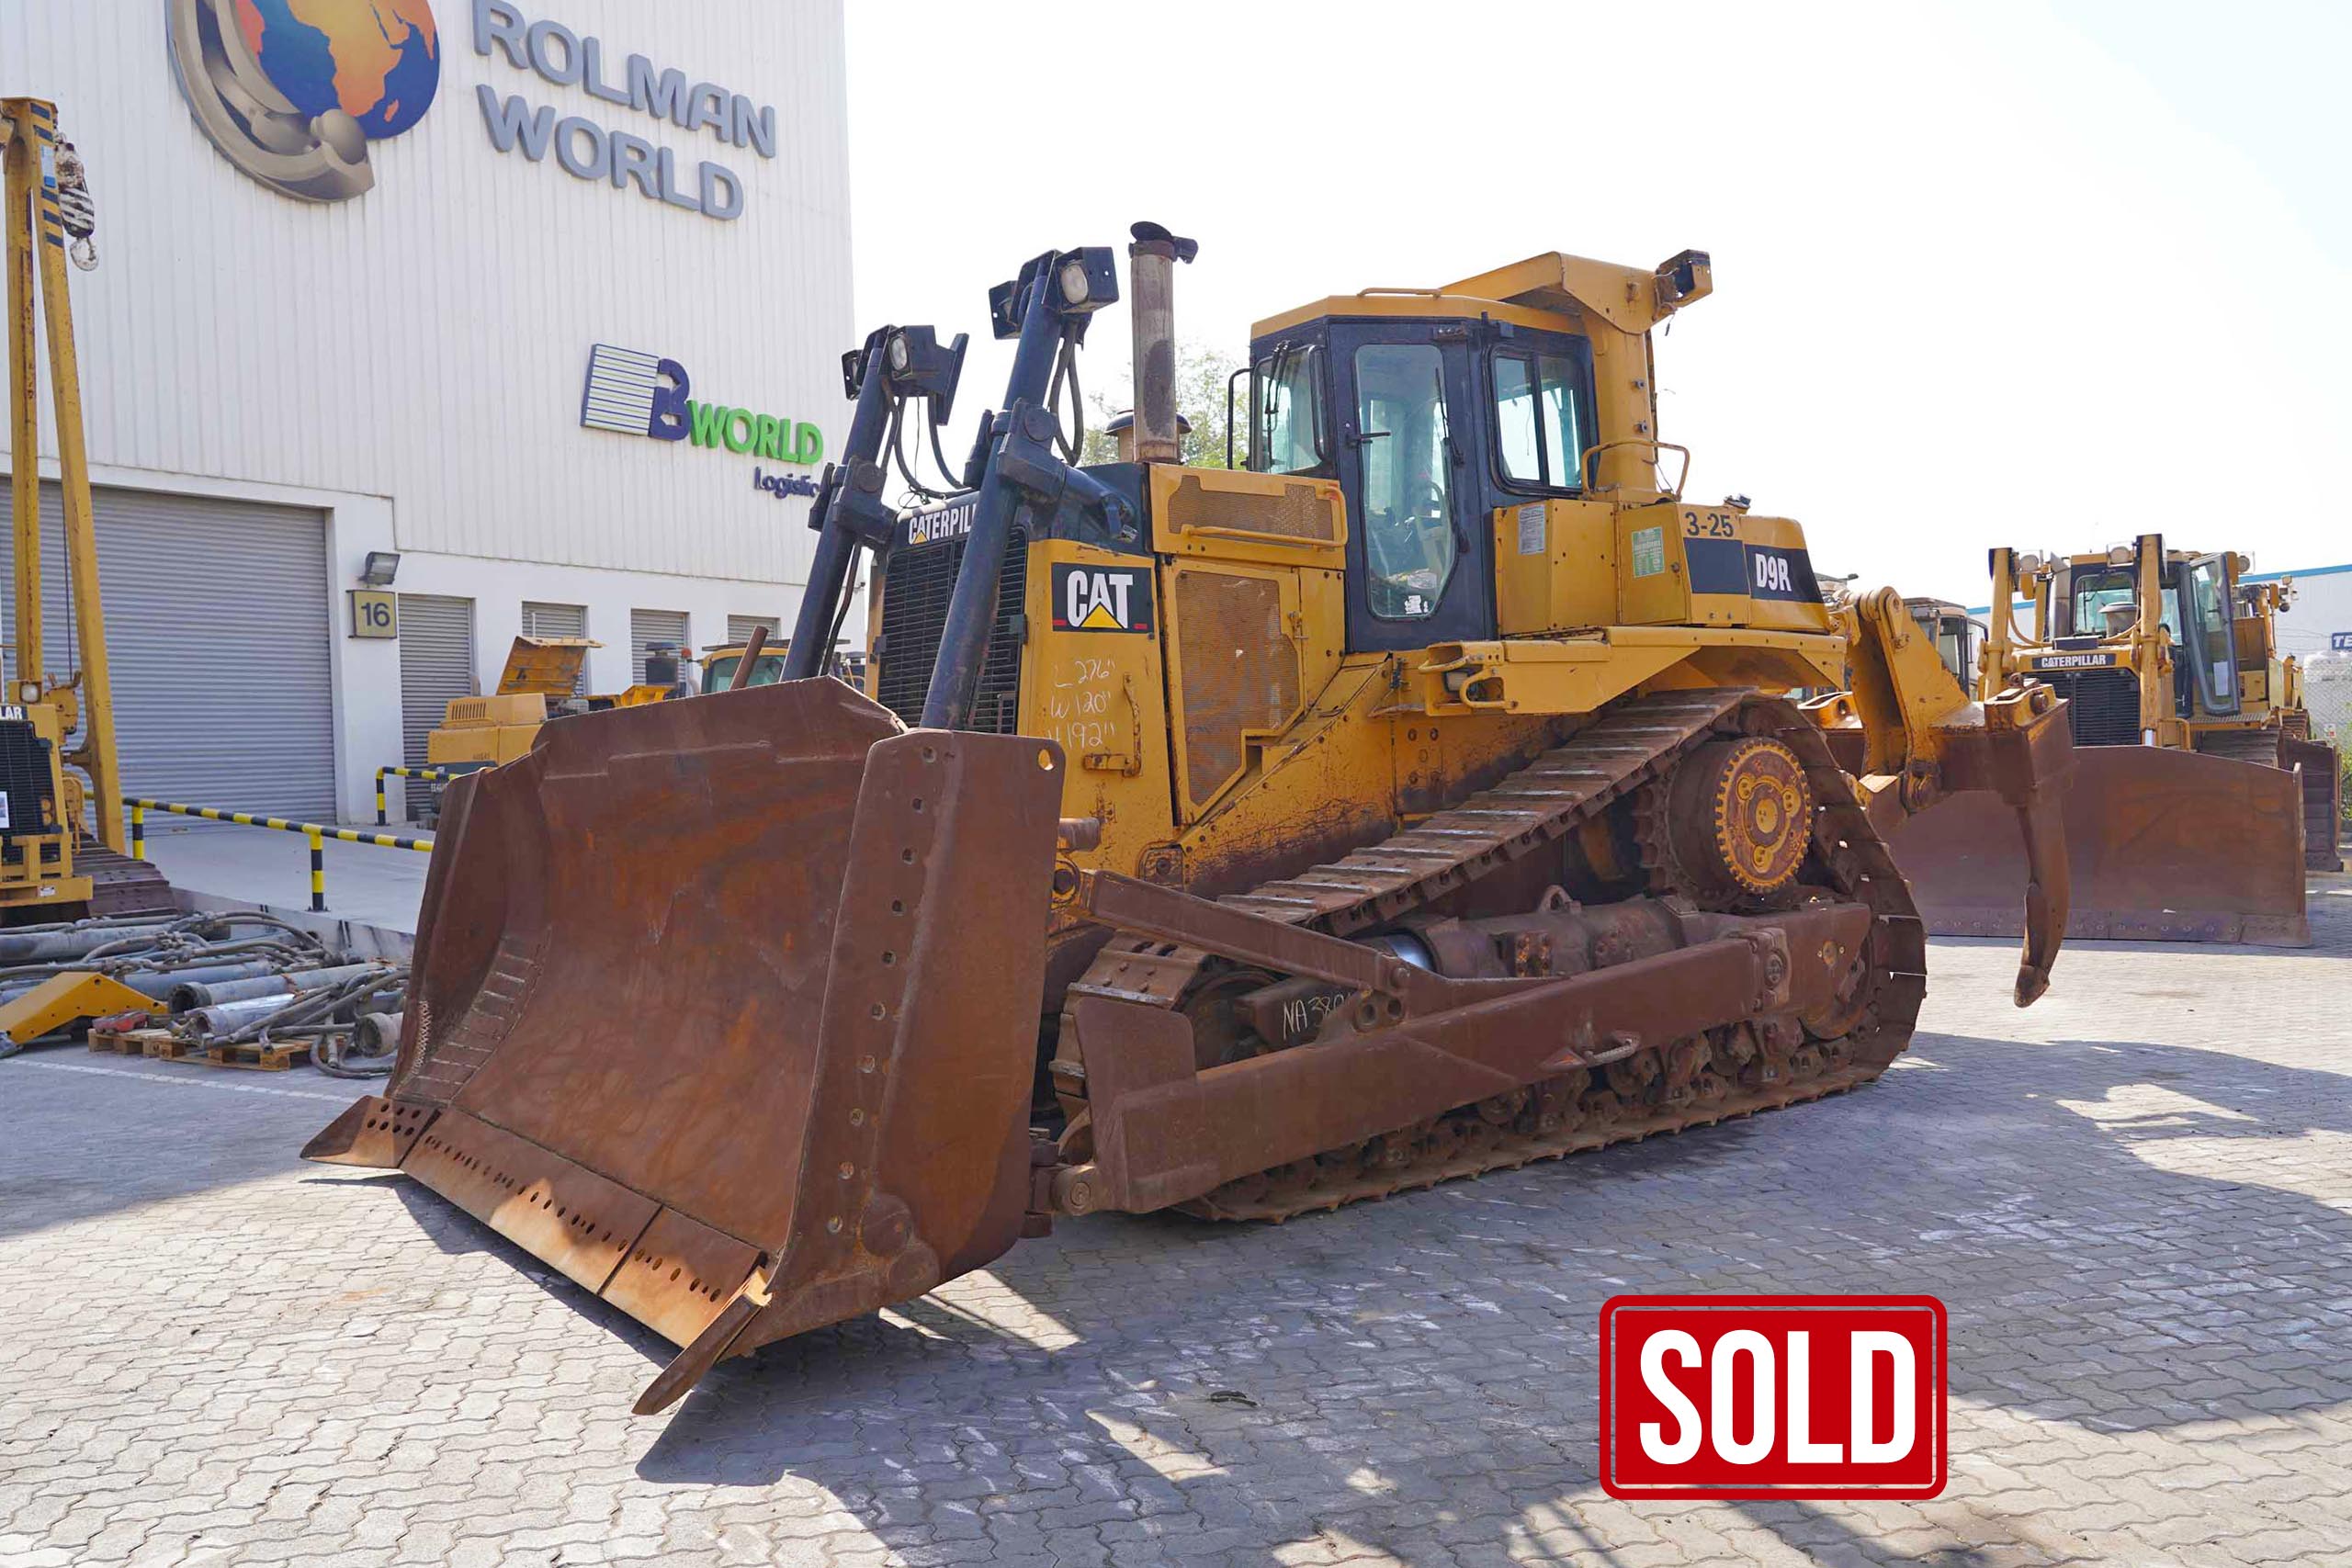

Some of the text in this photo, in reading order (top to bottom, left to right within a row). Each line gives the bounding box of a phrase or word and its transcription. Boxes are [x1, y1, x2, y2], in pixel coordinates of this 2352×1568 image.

[471, 0, 776, 159] ROLMAN
[476, 84, 744, 221] WORLD
[753, 466, 820, 499] Logistic
[908, 502, 977, 545] CATERPIL
[1685, 511, 1734, 537] 3-25
[1755, 553, 1792, 592] D9R
[360, 602, 390, 626] 16
[1067, 570, 1134, 629] CAT
[2041, 654, 2106, 668] CATERPILLAR
